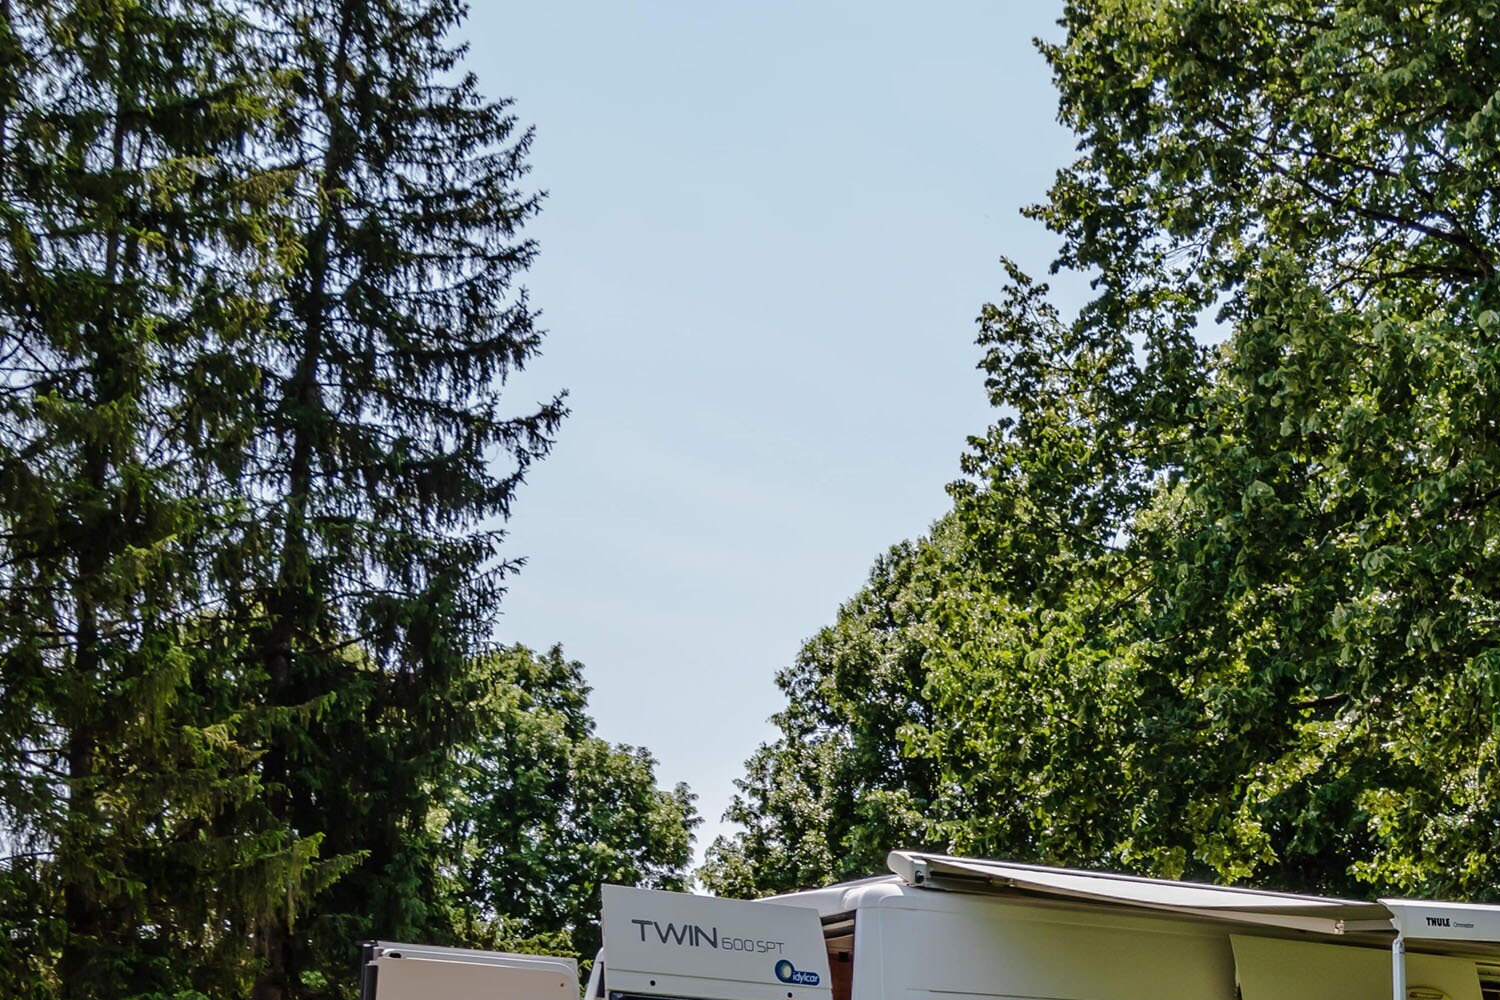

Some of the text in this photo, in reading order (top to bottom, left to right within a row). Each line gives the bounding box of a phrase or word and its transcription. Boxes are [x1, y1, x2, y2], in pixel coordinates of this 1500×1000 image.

[1425, 917, 1451, 928] THULE
[632, 919, 785, 955] TWIN 600 SPT
